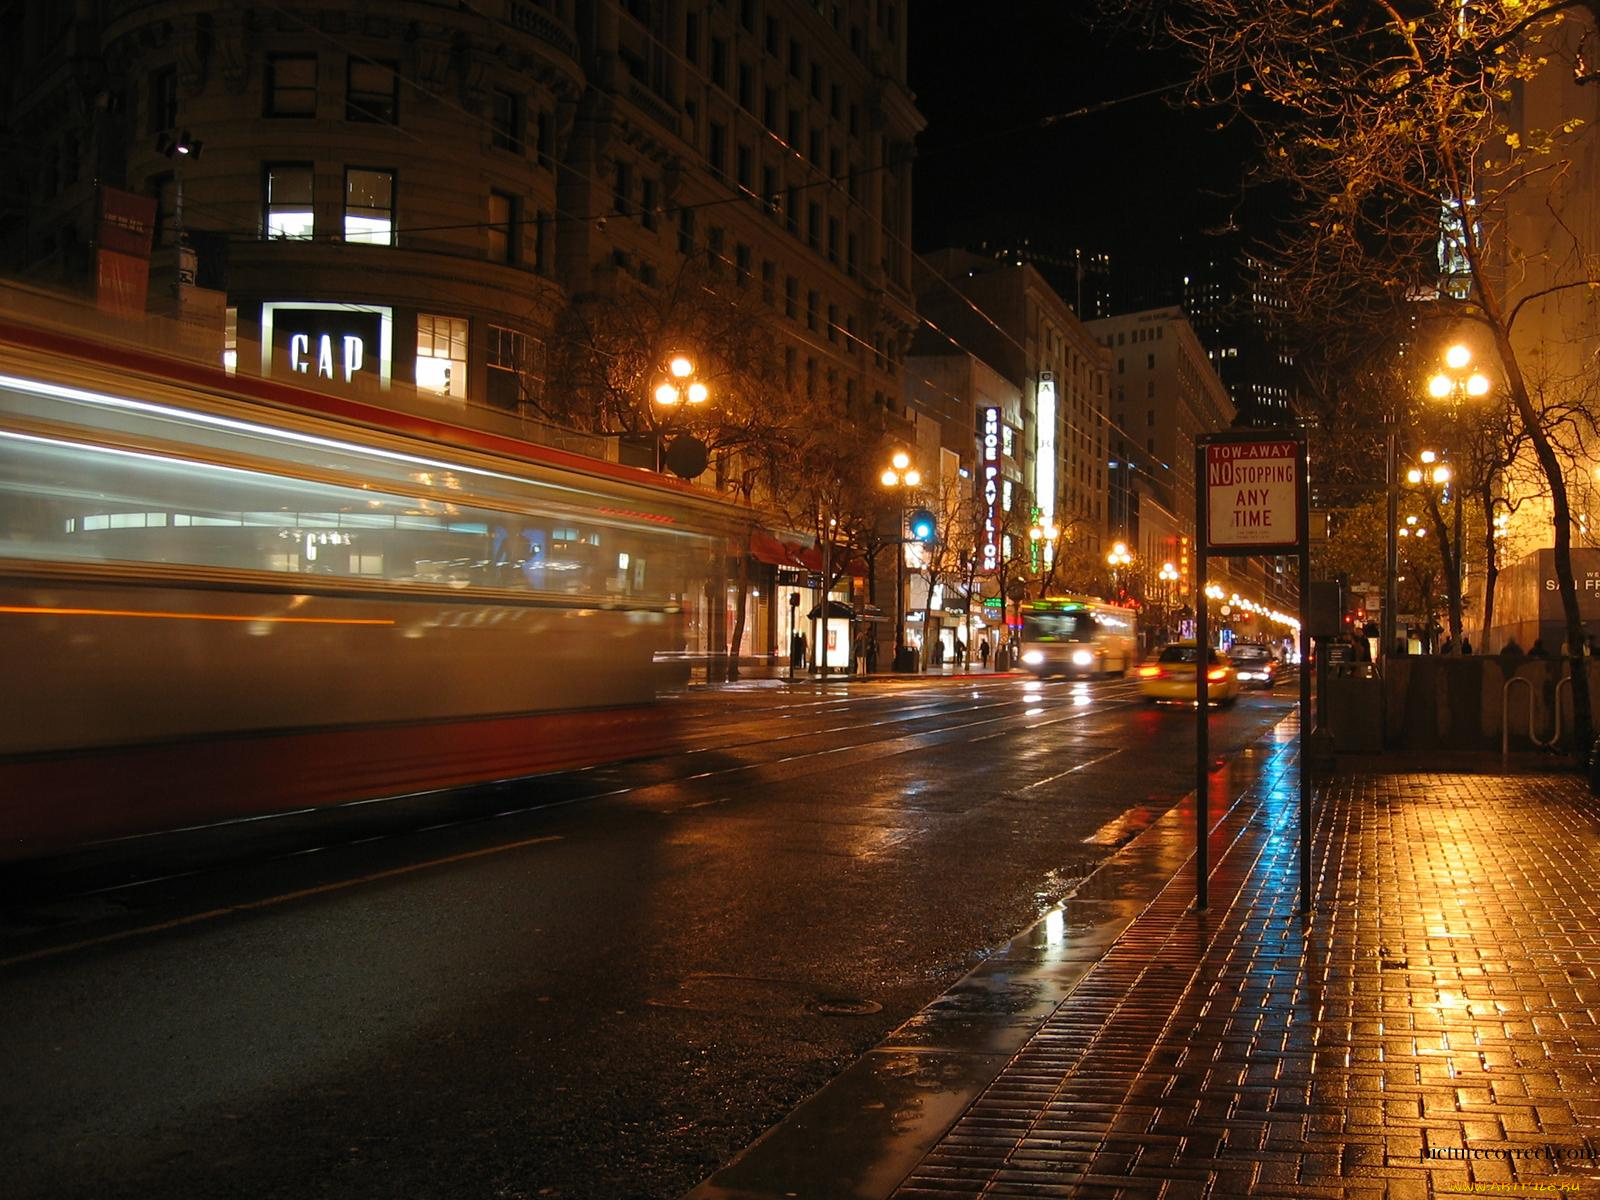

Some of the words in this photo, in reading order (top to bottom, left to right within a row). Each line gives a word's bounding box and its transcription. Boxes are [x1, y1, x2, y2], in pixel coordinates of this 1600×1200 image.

[291, 334, 364, 383] GAP
[985, 409, 997, 460] SHOE
[1213, 446, 1290, 458] TOW-AWAY
[1210, 462, 1232, 485] NO
[1235, 465, 1293, 484] STOPPING
[1236, 489, 1270, 506] ANY
[984, 467, 997, 570] PAVILION
[1233, 510, 1272, 527] TIME
